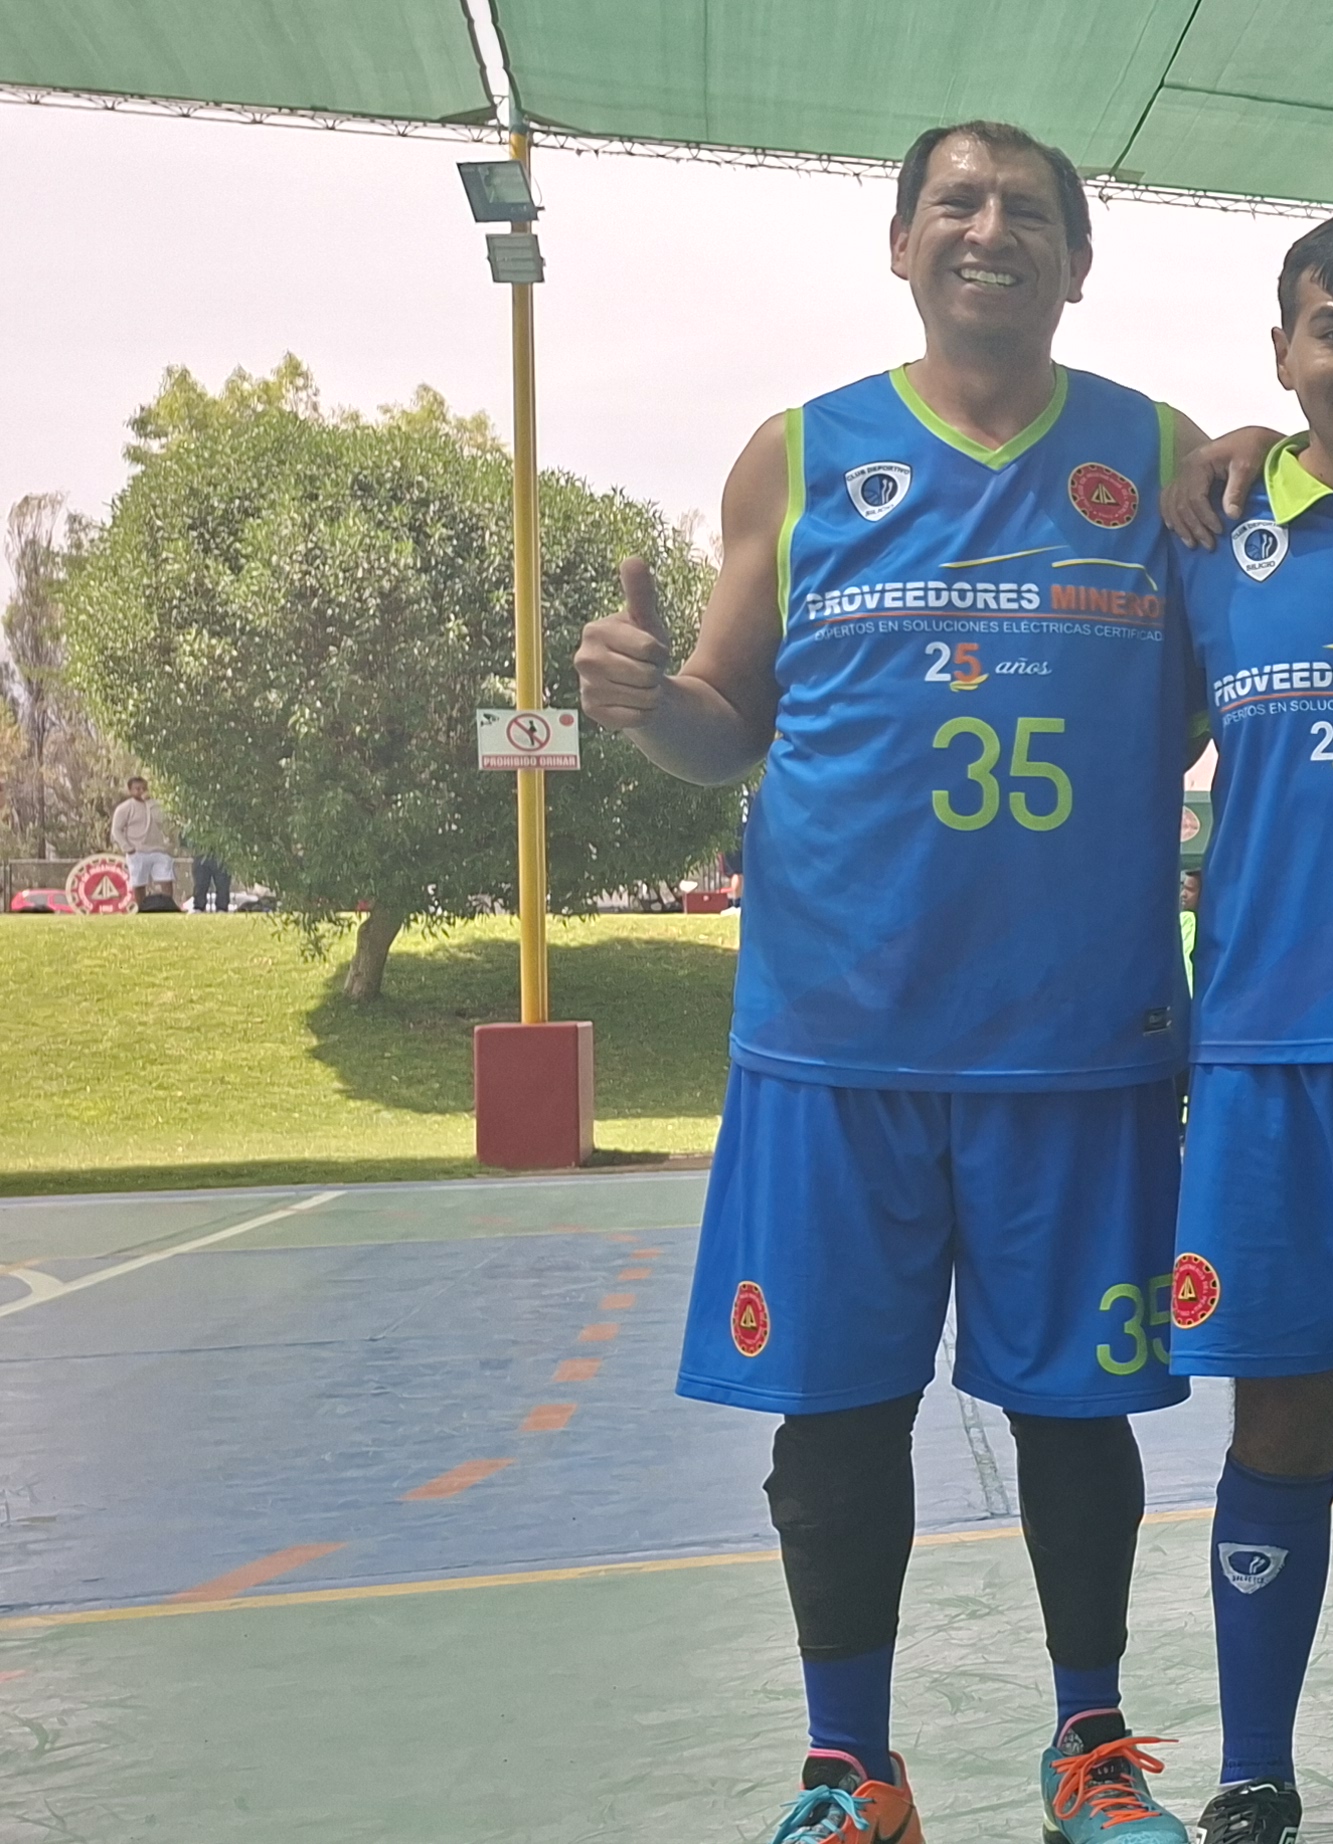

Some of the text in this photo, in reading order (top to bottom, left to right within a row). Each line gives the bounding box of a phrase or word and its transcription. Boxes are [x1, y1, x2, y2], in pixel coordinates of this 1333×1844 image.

[806, 581, 1040, 619] PROVEEDORES
[815, 620, 875, 641] EXPERTOS
[879, 619, 899, 633] EN
[903, 619, 999, 633] SOLUCIONES
[1004, 617, 1091, 636] ELÉCTRICAS
[925, 641, 1052, 682] 25 años
[1222, 702, 1266, 727] EXPERTOS
[1269, 700, 1287, 714] EN
[483, 756, 576, 767] PROHIBIDO ORINAR
[932, 716, 1073, 831] 35
